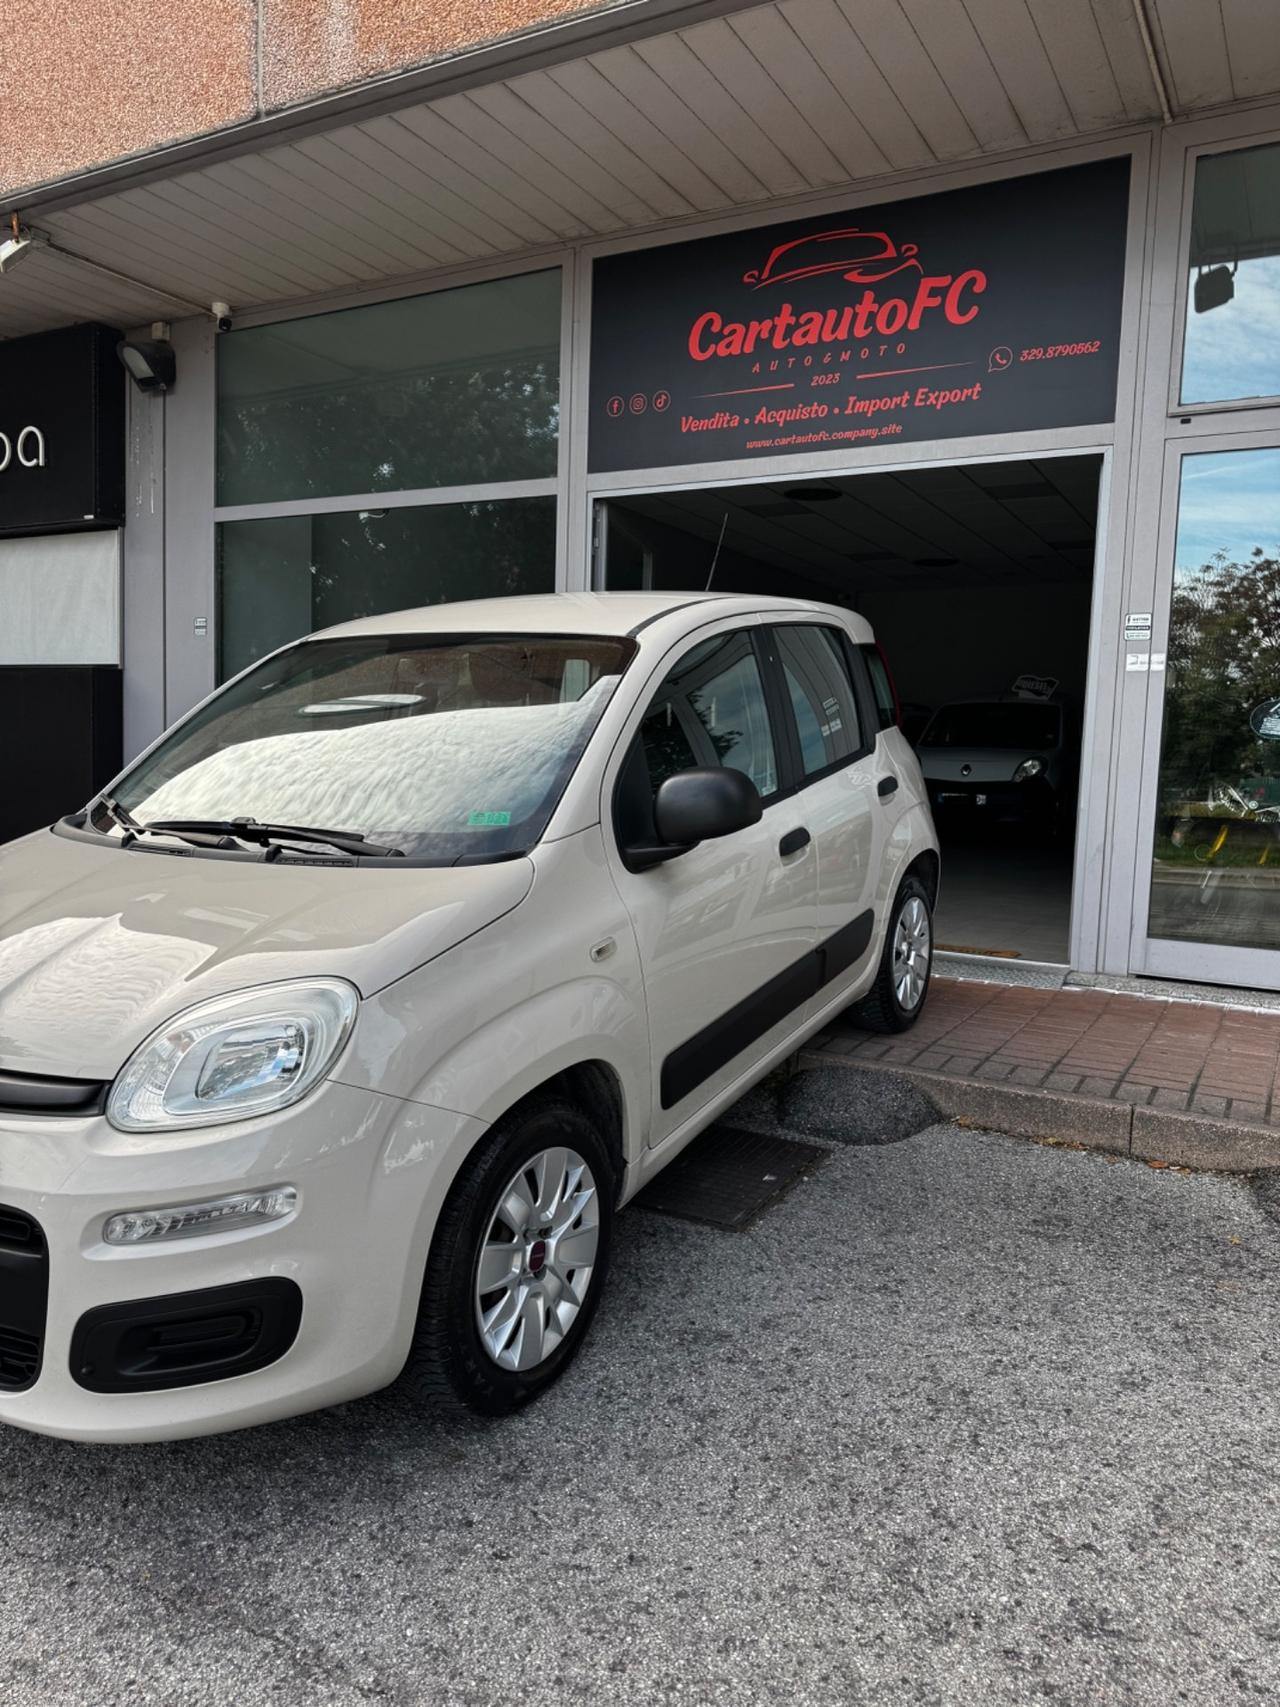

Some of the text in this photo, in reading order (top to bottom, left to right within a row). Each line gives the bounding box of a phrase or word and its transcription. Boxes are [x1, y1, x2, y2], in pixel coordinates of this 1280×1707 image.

[688, 268, 987, 362] CartautoFC
[1020, 340, 1101, 361] 329.8790562
[811, 373, 840, 386] 2023
[680, 382, 982, 433] Vendita Acquisto Import Export
[746, 423, 902, 449] www.cartautofc.company.site
